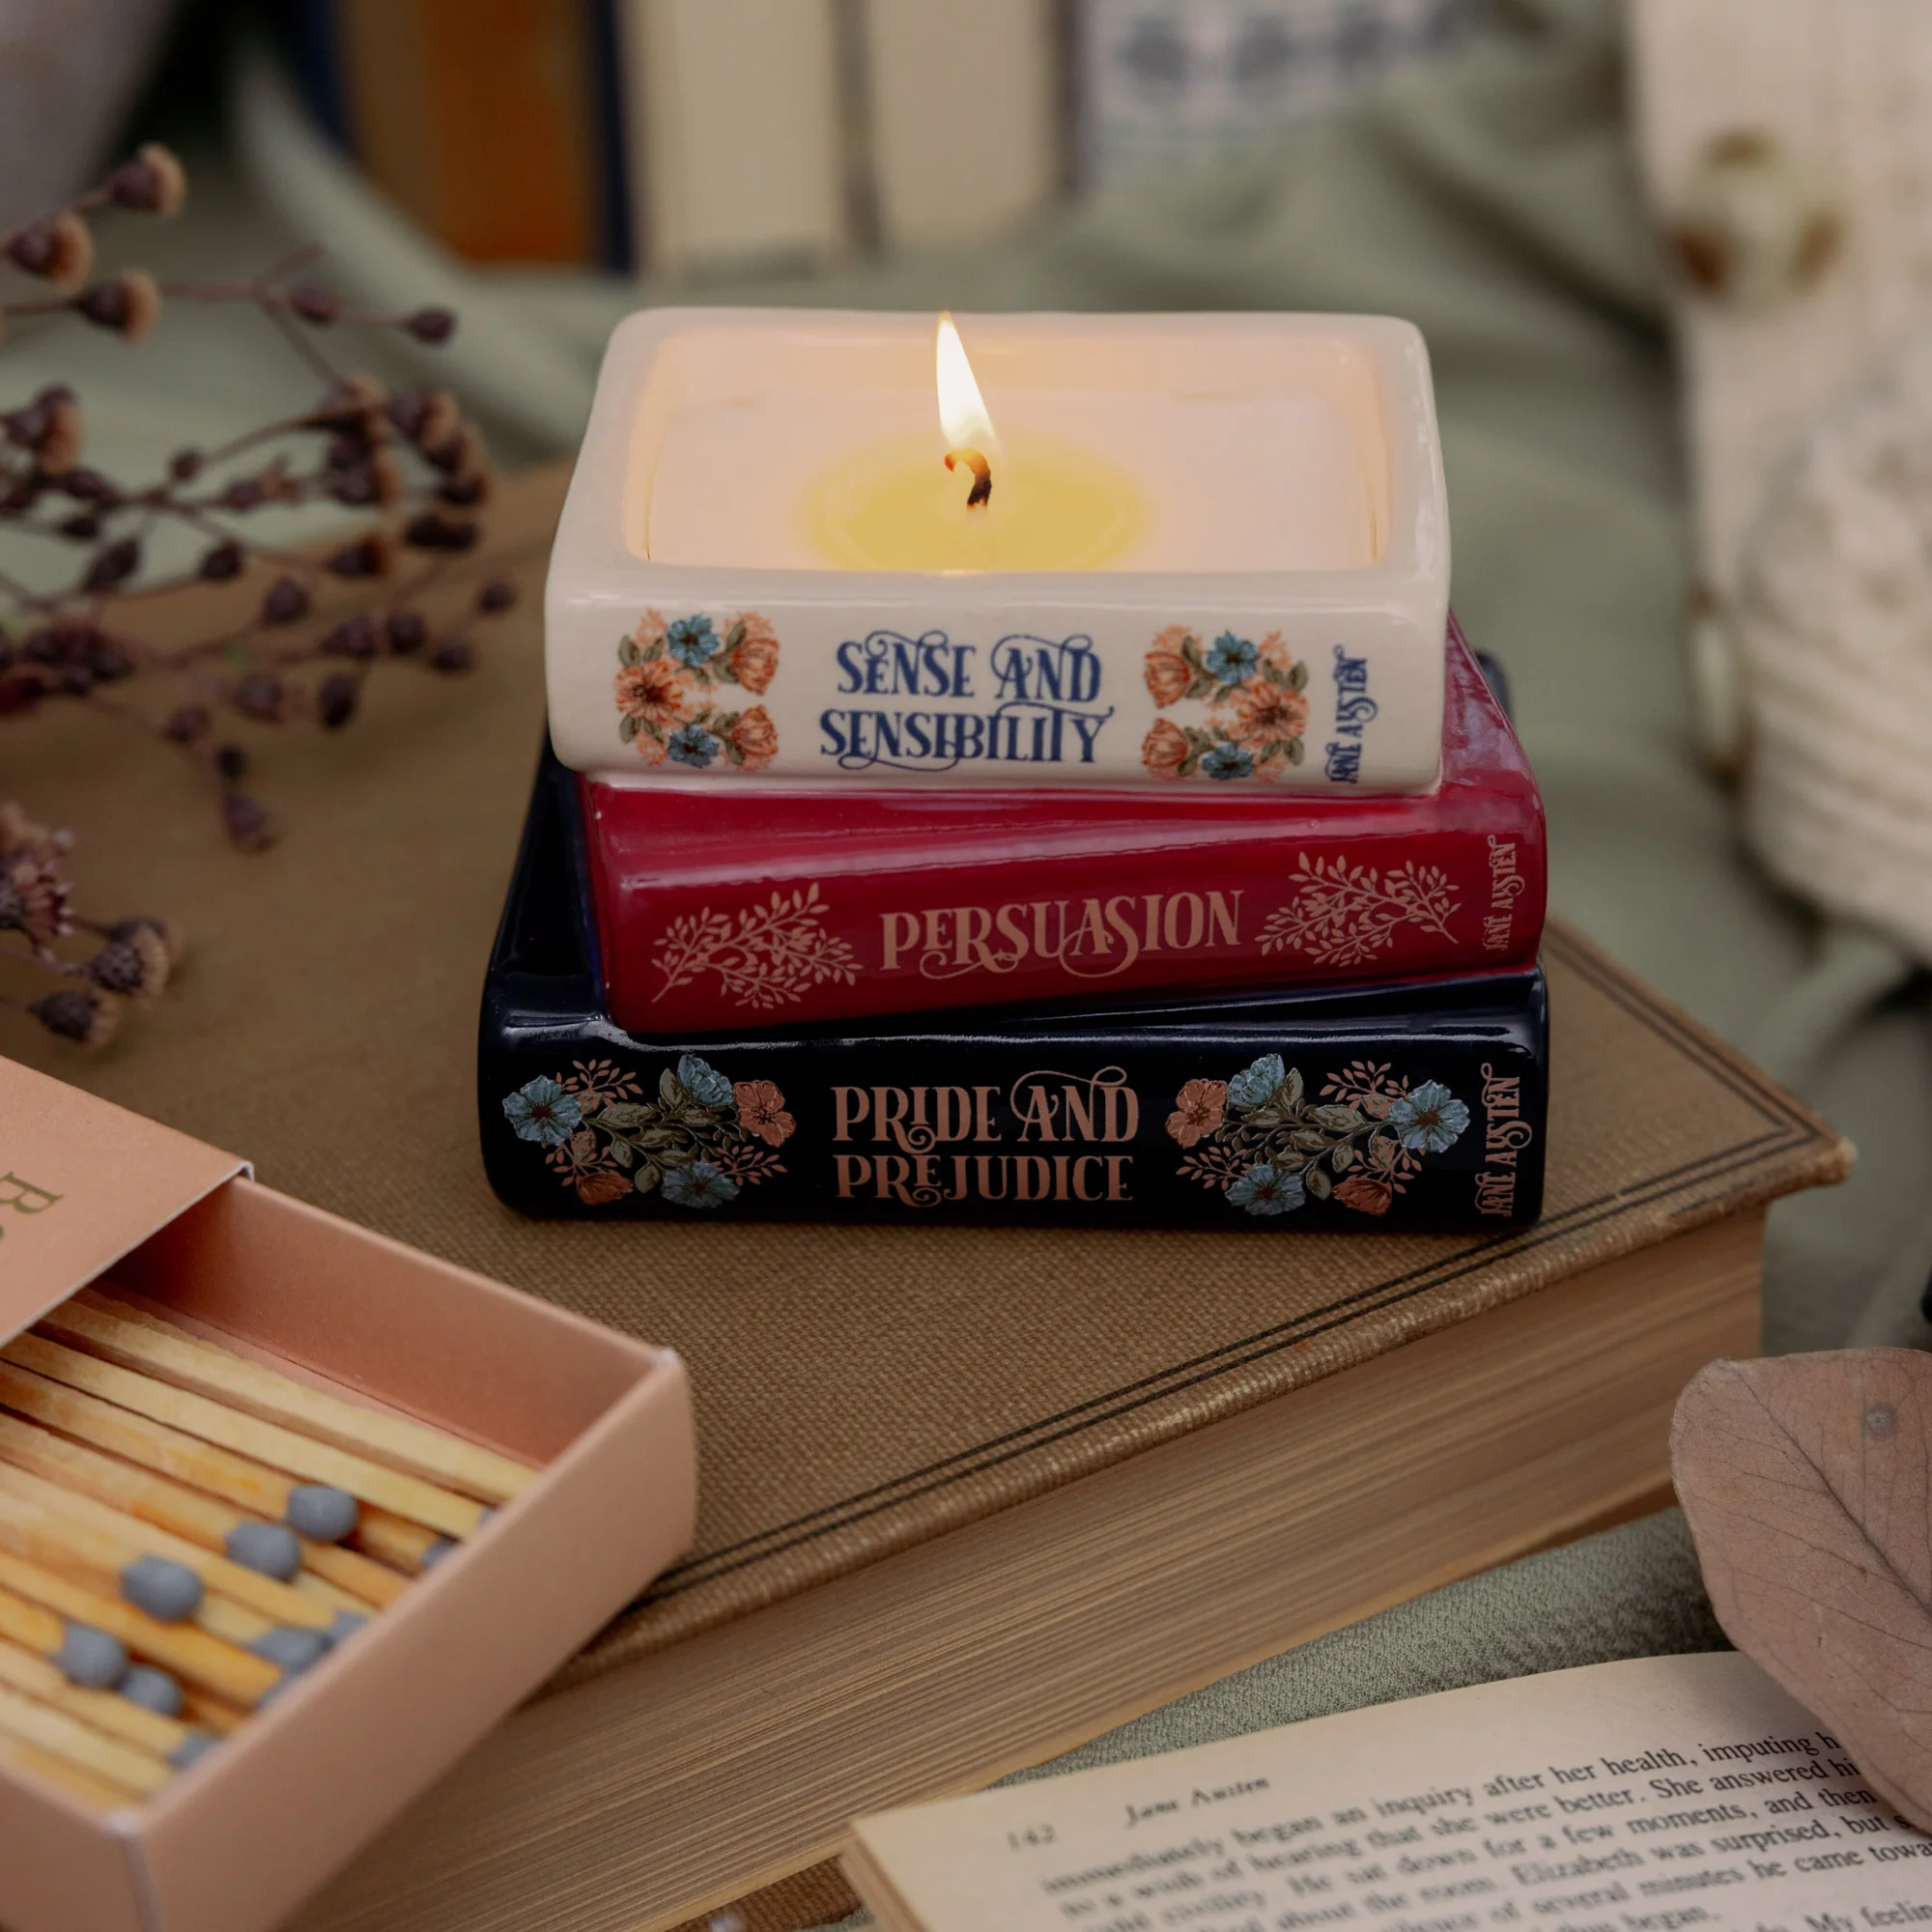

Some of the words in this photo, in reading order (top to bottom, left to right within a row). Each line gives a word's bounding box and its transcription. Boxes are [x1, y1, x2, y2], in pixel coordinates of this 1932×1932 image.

[837, 630, 977, 697] SENSE
[990, 634, 1102, 703] AND
[1332, 643, 1378, 738] AUSTEN
[819, 700, 1115, 772] SENSIBILITY
[1487, 835, 1526, 909] AUSTEN
[879, 889, 1245, 980] PERSUASION
[831, 1084, 1001, 1154] PRIDE
[1009, 1065, 1140, 1143] AND
[1480, 1063, 1533, 1168] AUSTEN
[832, 1153, 1134, 1208] PREJUDICE
[1475, 1172, 1517, 1217] JANE
[1123, 1799, 1181, 1830] Jane
[1190, 1776, 1271, 1808] Austen
[1331, 1804, 1369, 1828] an
[1370, 1786, 1474, 1822] inquiry
[1482, 1774, 1546, 1799] after
[1548, 1765, 1598, 1785] her
[1600, 1747, 1698, 1777] health,
[1697, 1734, 1820, 1764] imputing
[1484, 1802, 1553, 1828] were
[1552, 1787, 1648, 1816] better.
[1649, 1776, 1705, 1801] She
[1708, 1759, 1830, 1793] answered
[1828, 1756, 1861, 1776] hi
[1536, 1833, 1558, 1851] a
[1561, 1824, 1614, 1846] few
[1625, 1802, 1760, 1836] moments,
[1763, 1790, 1815, 1816] and
[1818, 1787, 1879, 1807] then
[1650, 1840, 1707, 1862] was
[1709, 1818, 1843, 1854] surprised,
[1839, 1815, 1890, 1835] but
[1747, 1858, 1788, 1880] he
[1794, 1848, 1865, 1874] came
[1867, 1840, 1932, 1863] towa
